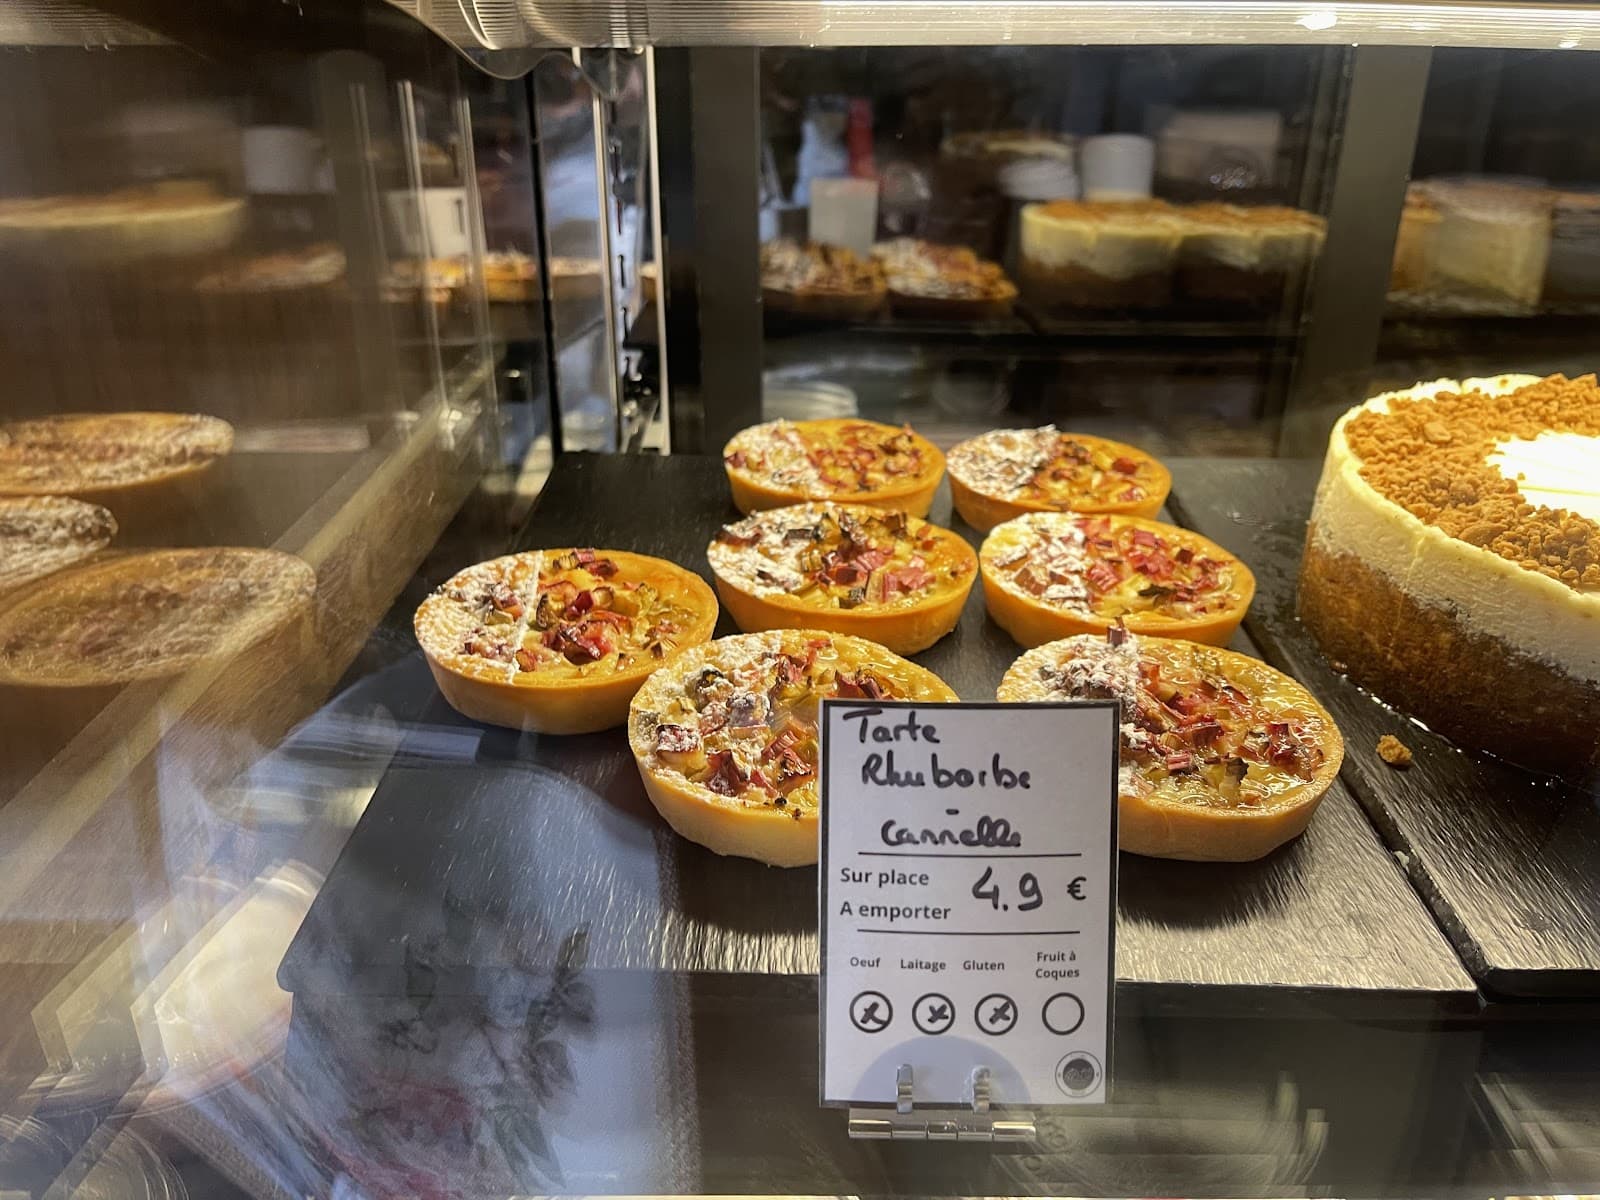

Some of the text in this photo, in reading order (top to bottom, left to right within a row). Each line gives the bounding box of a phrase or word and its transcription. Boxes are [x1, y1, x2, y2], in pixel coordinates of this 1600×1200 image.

[843, 709, 941, 743] Tarte
[881, 815, 1022, 847] Cannelle
[840, 868, 929, 888] Sur place
[971, 866, 1087, 912] 4.9 €
[840, 902, 951, 922] A emporter
[850, 956, 881, 969] Oeuf
[1037, 950, 1077, 962] Fruit à
[900, 959, 946, 971] Laitage
[963, 960, 1005, 971] Gluten
[1035, 967, 1080, 979] Coques
